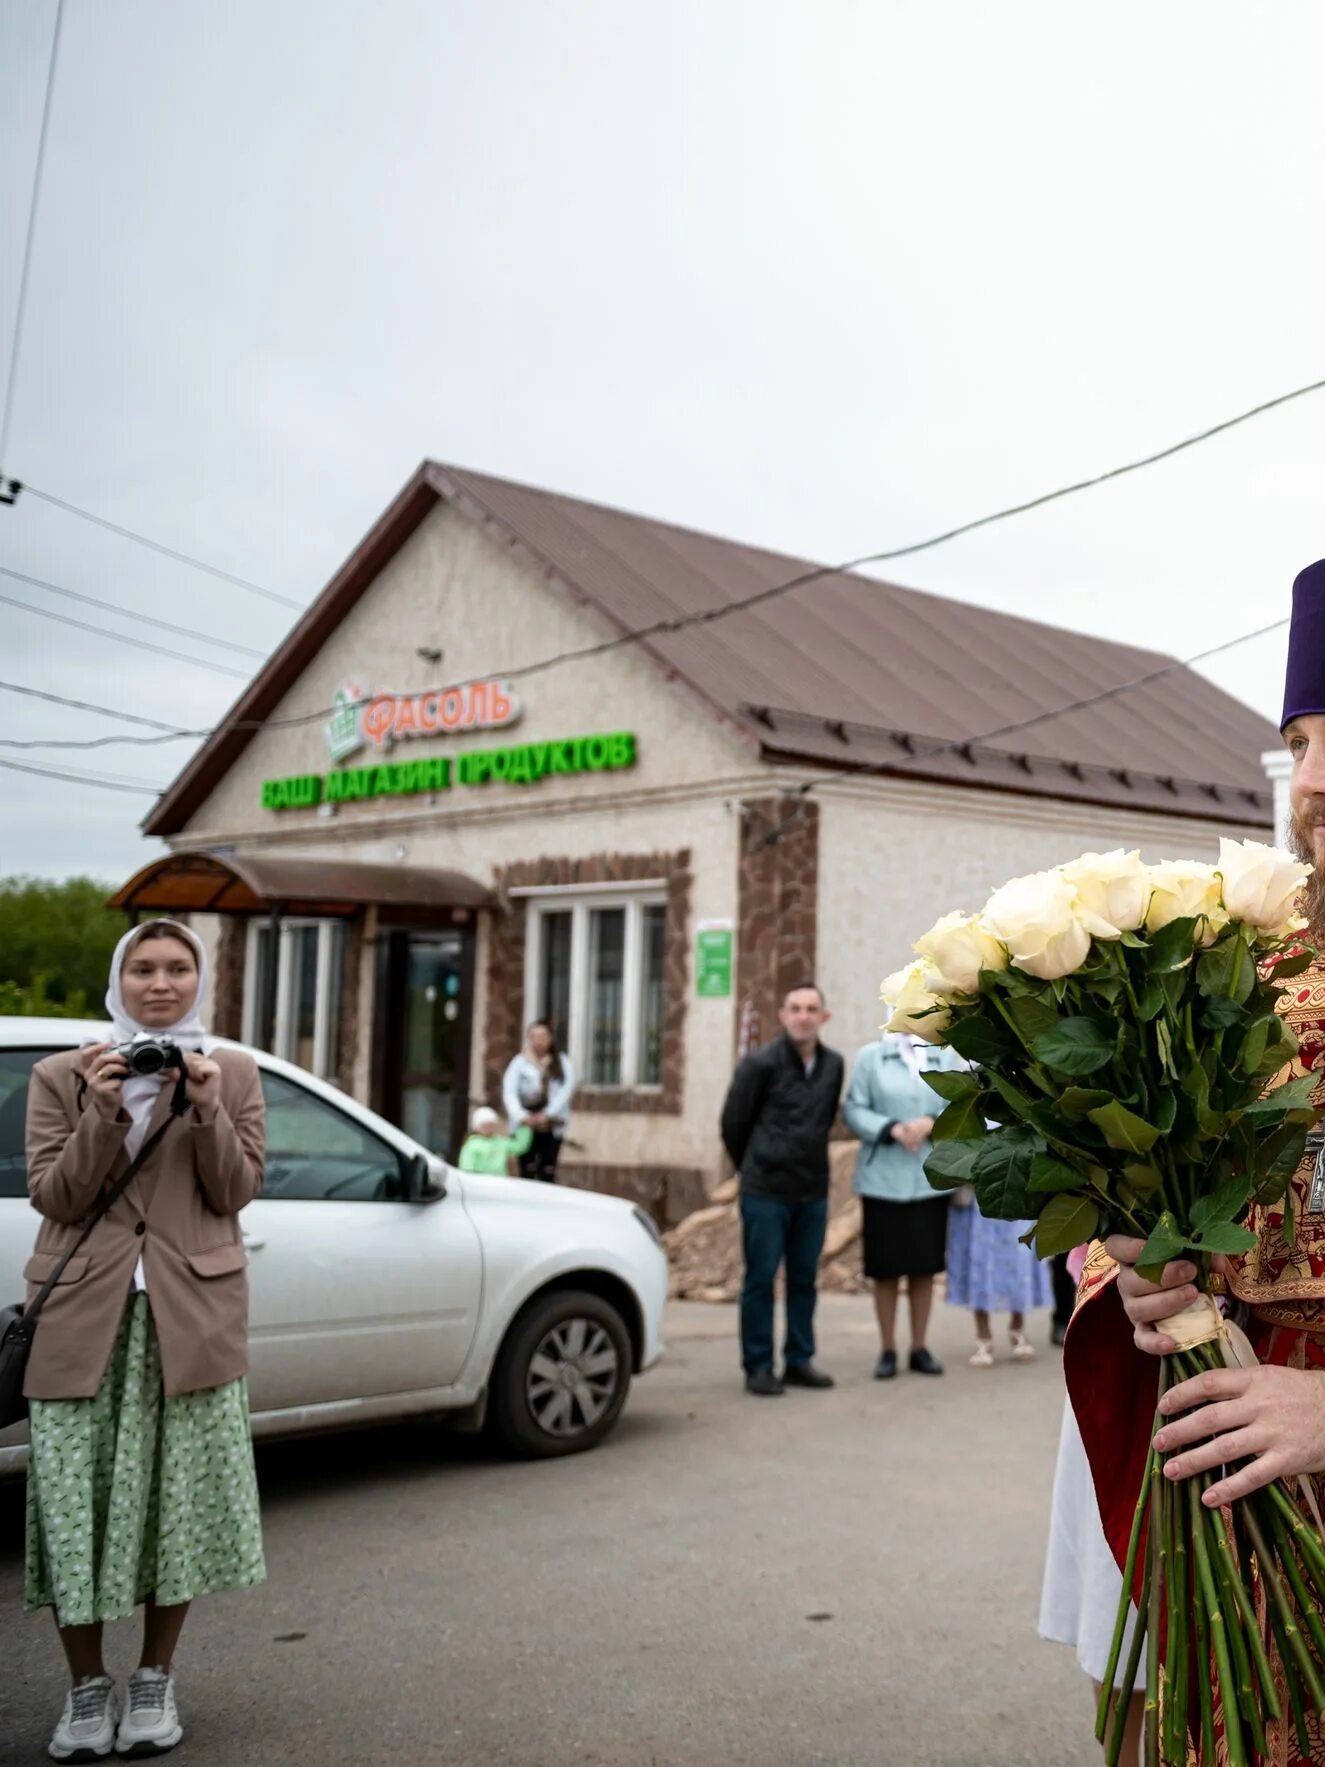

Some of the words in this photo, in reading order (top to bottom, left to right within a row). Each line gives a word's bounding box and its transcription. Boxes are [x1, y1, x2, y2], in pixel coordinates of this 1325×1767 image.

[363, 681, 511, 743] ФАСОЛЬ
[261, 777, 320, 809] ВАШ
[326, 758, 450, 801] МАГАЗИН
[457, 732, 635, 785] ПРОДУКТОВ
